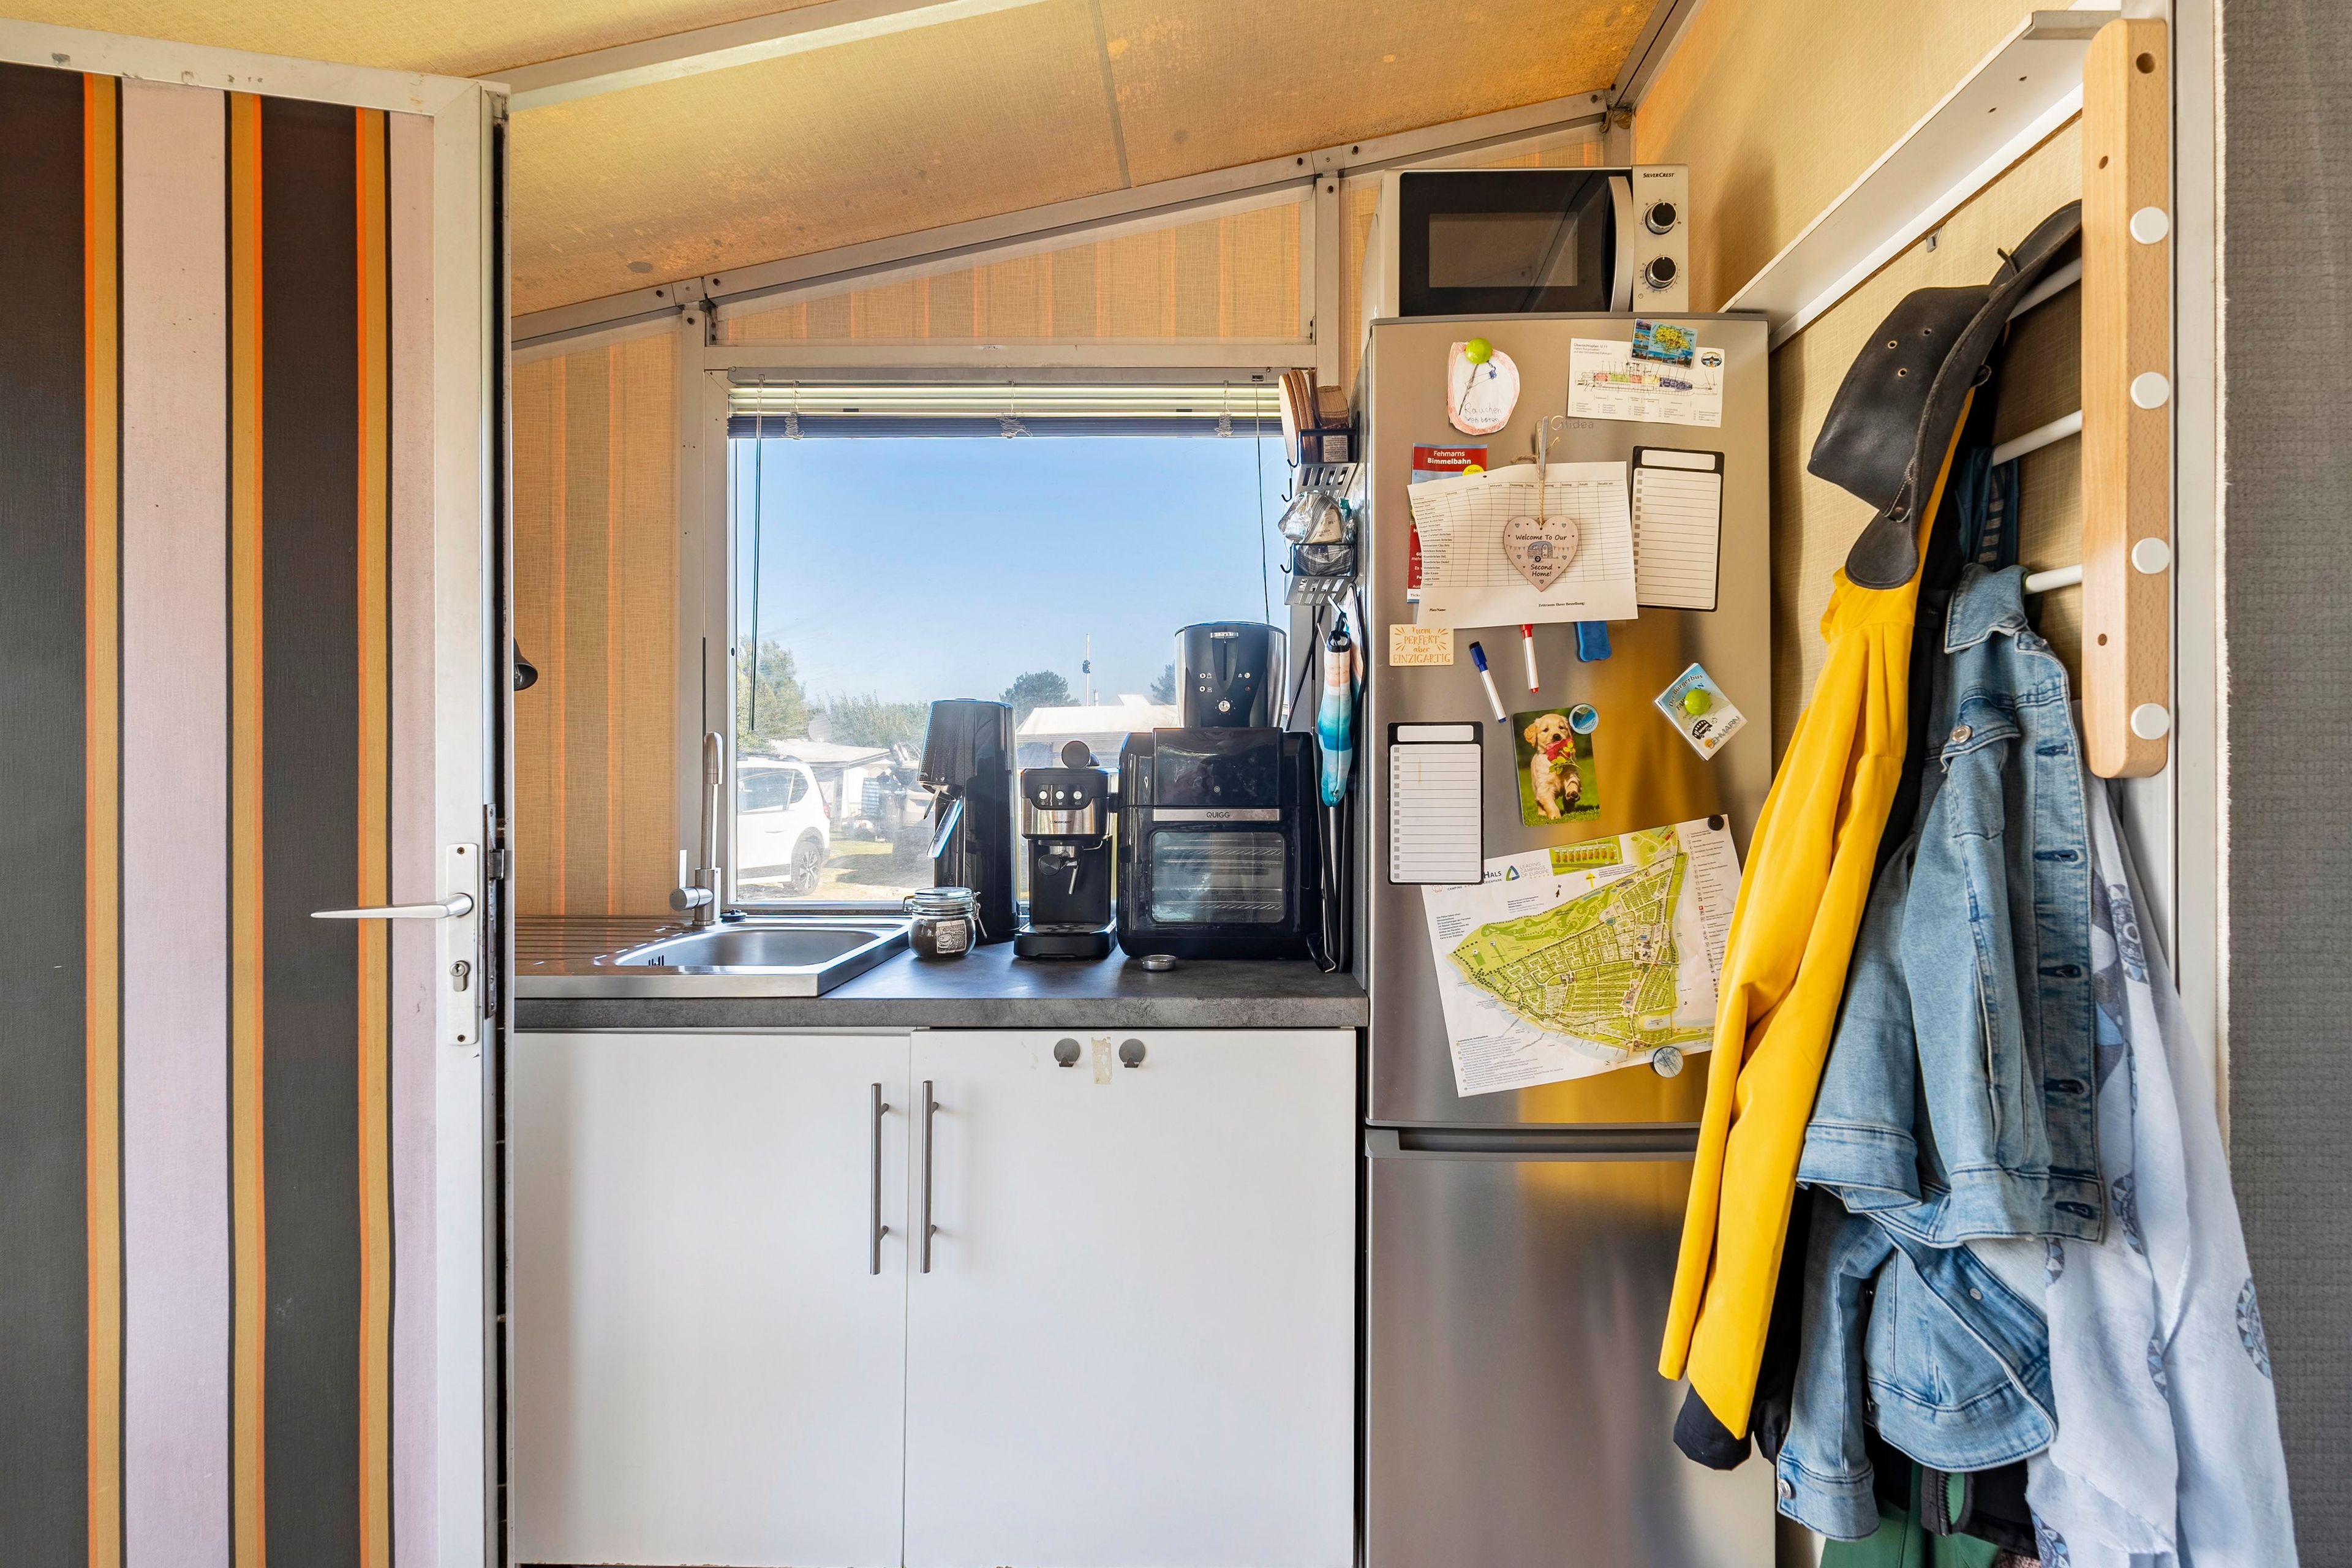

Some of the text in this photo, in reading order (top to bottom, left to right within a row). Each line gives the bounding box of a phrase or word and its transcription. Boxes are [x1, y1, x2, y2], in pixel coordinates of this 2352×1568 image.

[1464, 402, 1502, 415] Rauchen
[1404, 635, 1440, 645] PERFEKT
[1393, 653, 1451, 663] EINZIGARTIG
[1520, 861, 1542, 870] LEADING
[1520, 865, 1546, 874] CAMPINGS
[1529, 869, 1550, 877] EUROPE
